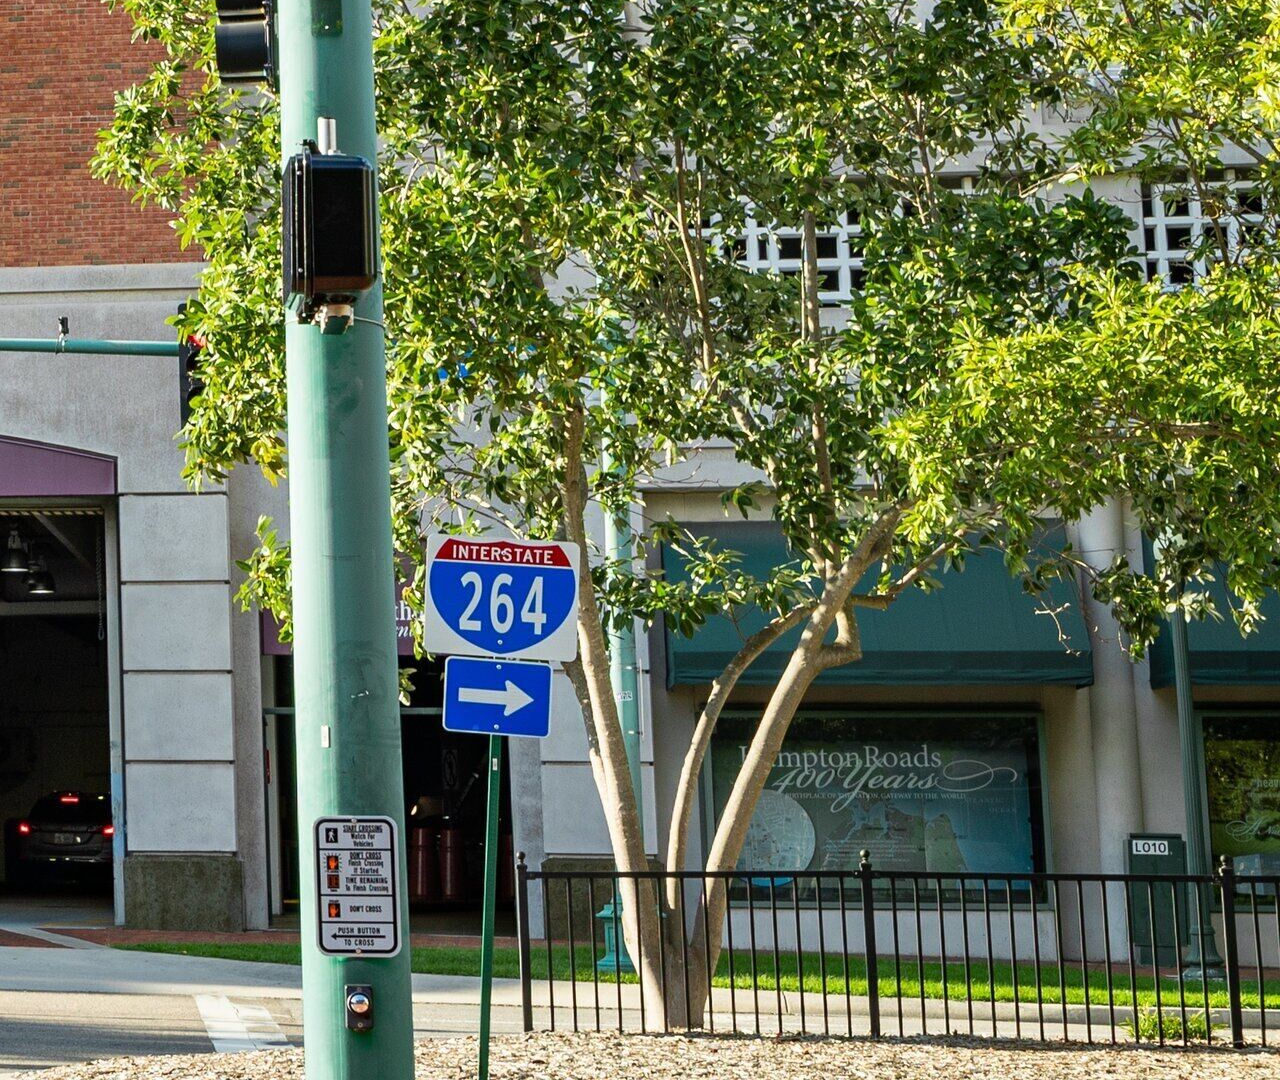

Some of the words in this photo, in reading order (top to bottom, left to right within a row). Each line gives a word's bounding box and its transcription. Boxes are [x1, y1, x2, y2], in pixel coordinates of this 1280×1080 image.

[452, 544, 553, 565] INTERSTATE
[458, 571, 547, 635] 264
[739, 746, 862, 775] mpton
[863, 744, 942, 768] Roads
[771, 767, 836, 794] 400
[831, 757, 940, 812] Years
[343, 824, 357, 832] START
[358, 824, 383, 832] CROSSING
[365, 851, 382, 859] CROSS
[364, 860, 384, 868] Crossing
[368, 885, 389, 893] Crossing
[349, 905, 364, 913] DON'T
[365, 905, 383, 913] CROSS
[354, 939, 375, 947] CROSS
